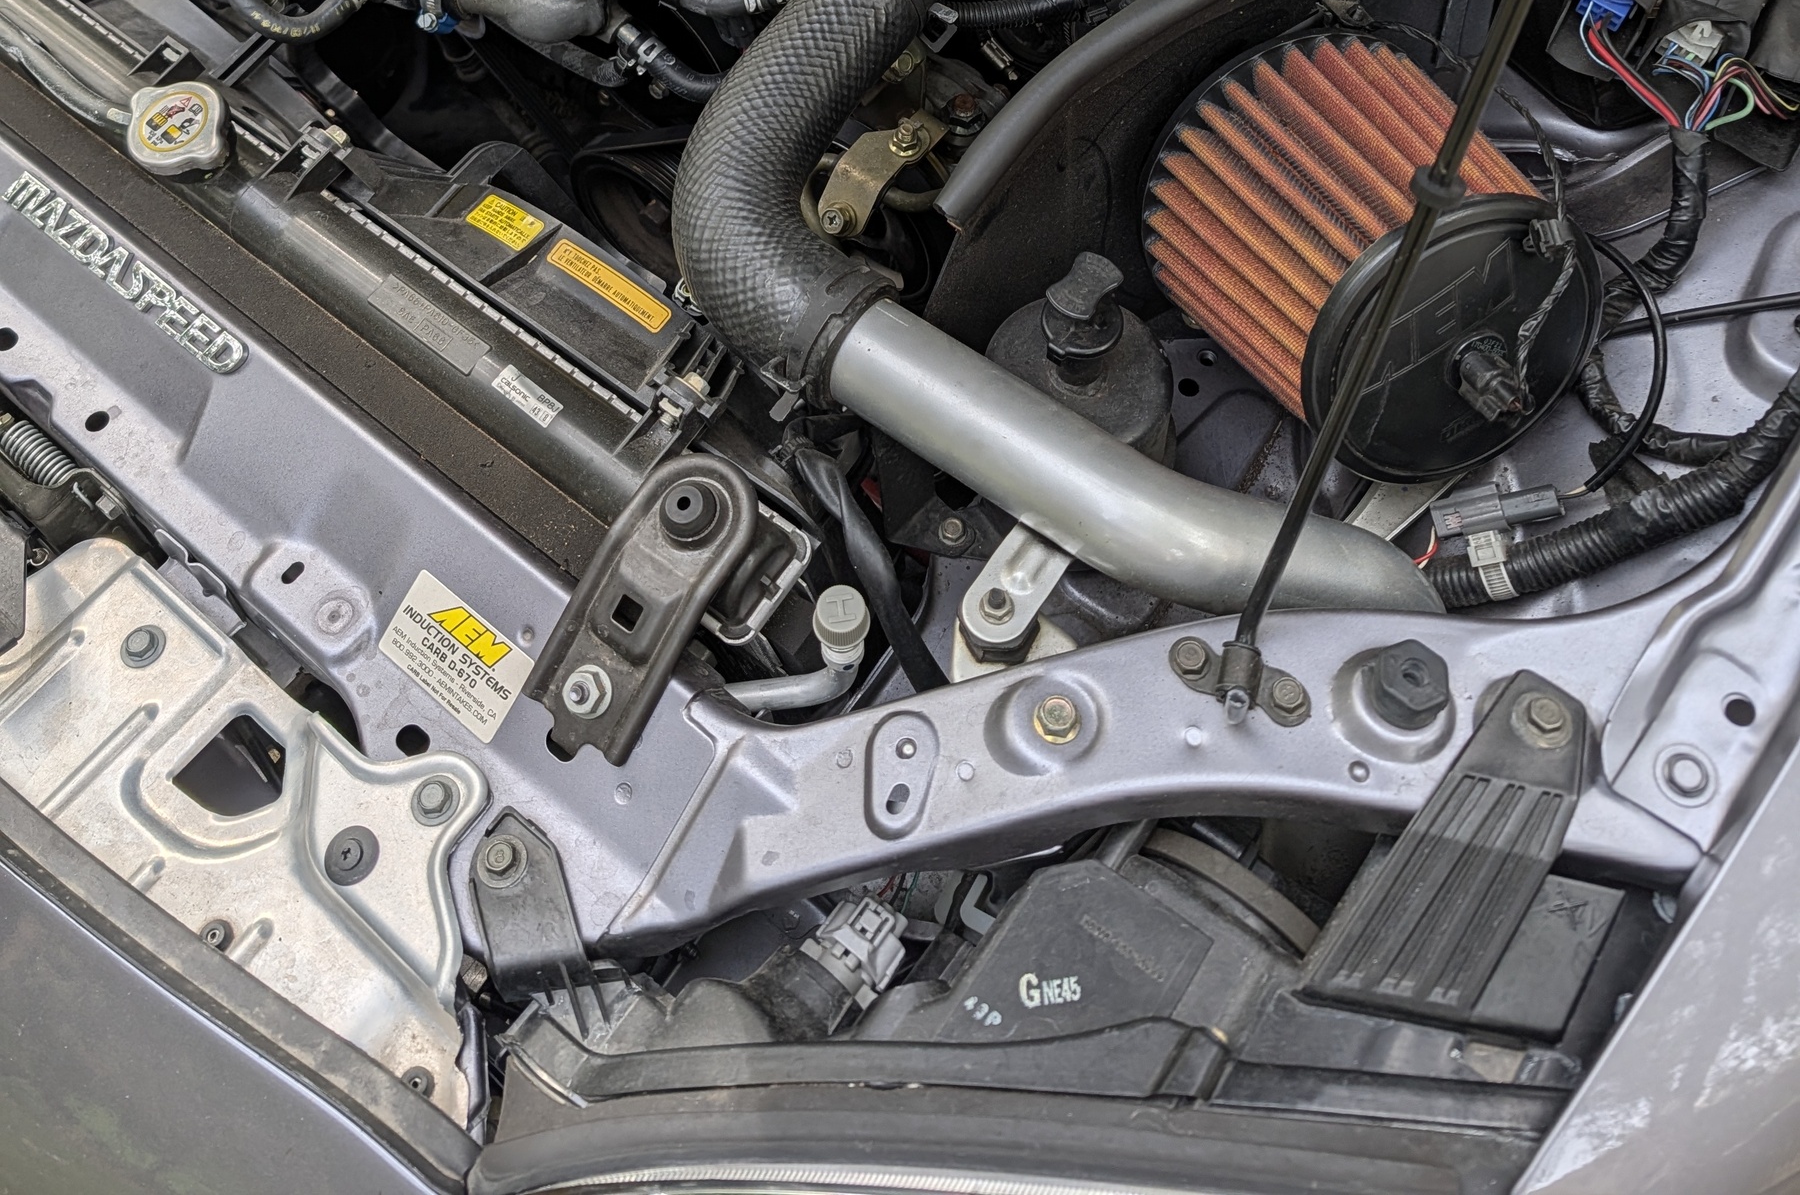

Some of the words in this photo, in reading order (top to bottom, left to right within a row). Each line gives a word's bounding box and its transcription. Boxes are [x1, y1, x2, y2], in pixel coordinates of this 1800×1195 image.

[485, 210, 499, 220] STARTS
[494, 201, 518, 217] CAUTION
[2, 170, 249, 375] MAZDASPEED
[563, 257, 591, 278] VENTILATEUR
[572, 253, 591, 267] TOUCHEZ
[589, 264, 602, 274] PAS.
[531, 405, 540, 415] 43
[402, 604, 459, 654] INDUCTION
[459, 653, 512, 700] SYSTEMS
[421, 637, 448, 663] CARB
[448, 660, 477, 688] D-670
[427, 606, 512, 669] AEM
[392, 626, 406, 641] AEM
[406, 637, 432, 661] Induction
[432, 658, 455, 683] Systems
[459, 684, 485, 711] Riverside,
[486, 708, 497, 720] CA
[392, 638, 434, 677] 800.992.3000
[437, 677, 488, 725] AEMINTAKES.COM
[406, 664, 420, 679] CARB
[420, 675, 432, 690] Label
[430, 685, 440, 696] Not
[439, 692, 447, 702] For
[446, 699, 461, 715] Resale
[1019, 973, 1042, 1009] G
[1041, 976, 1081, 1005] NE45
